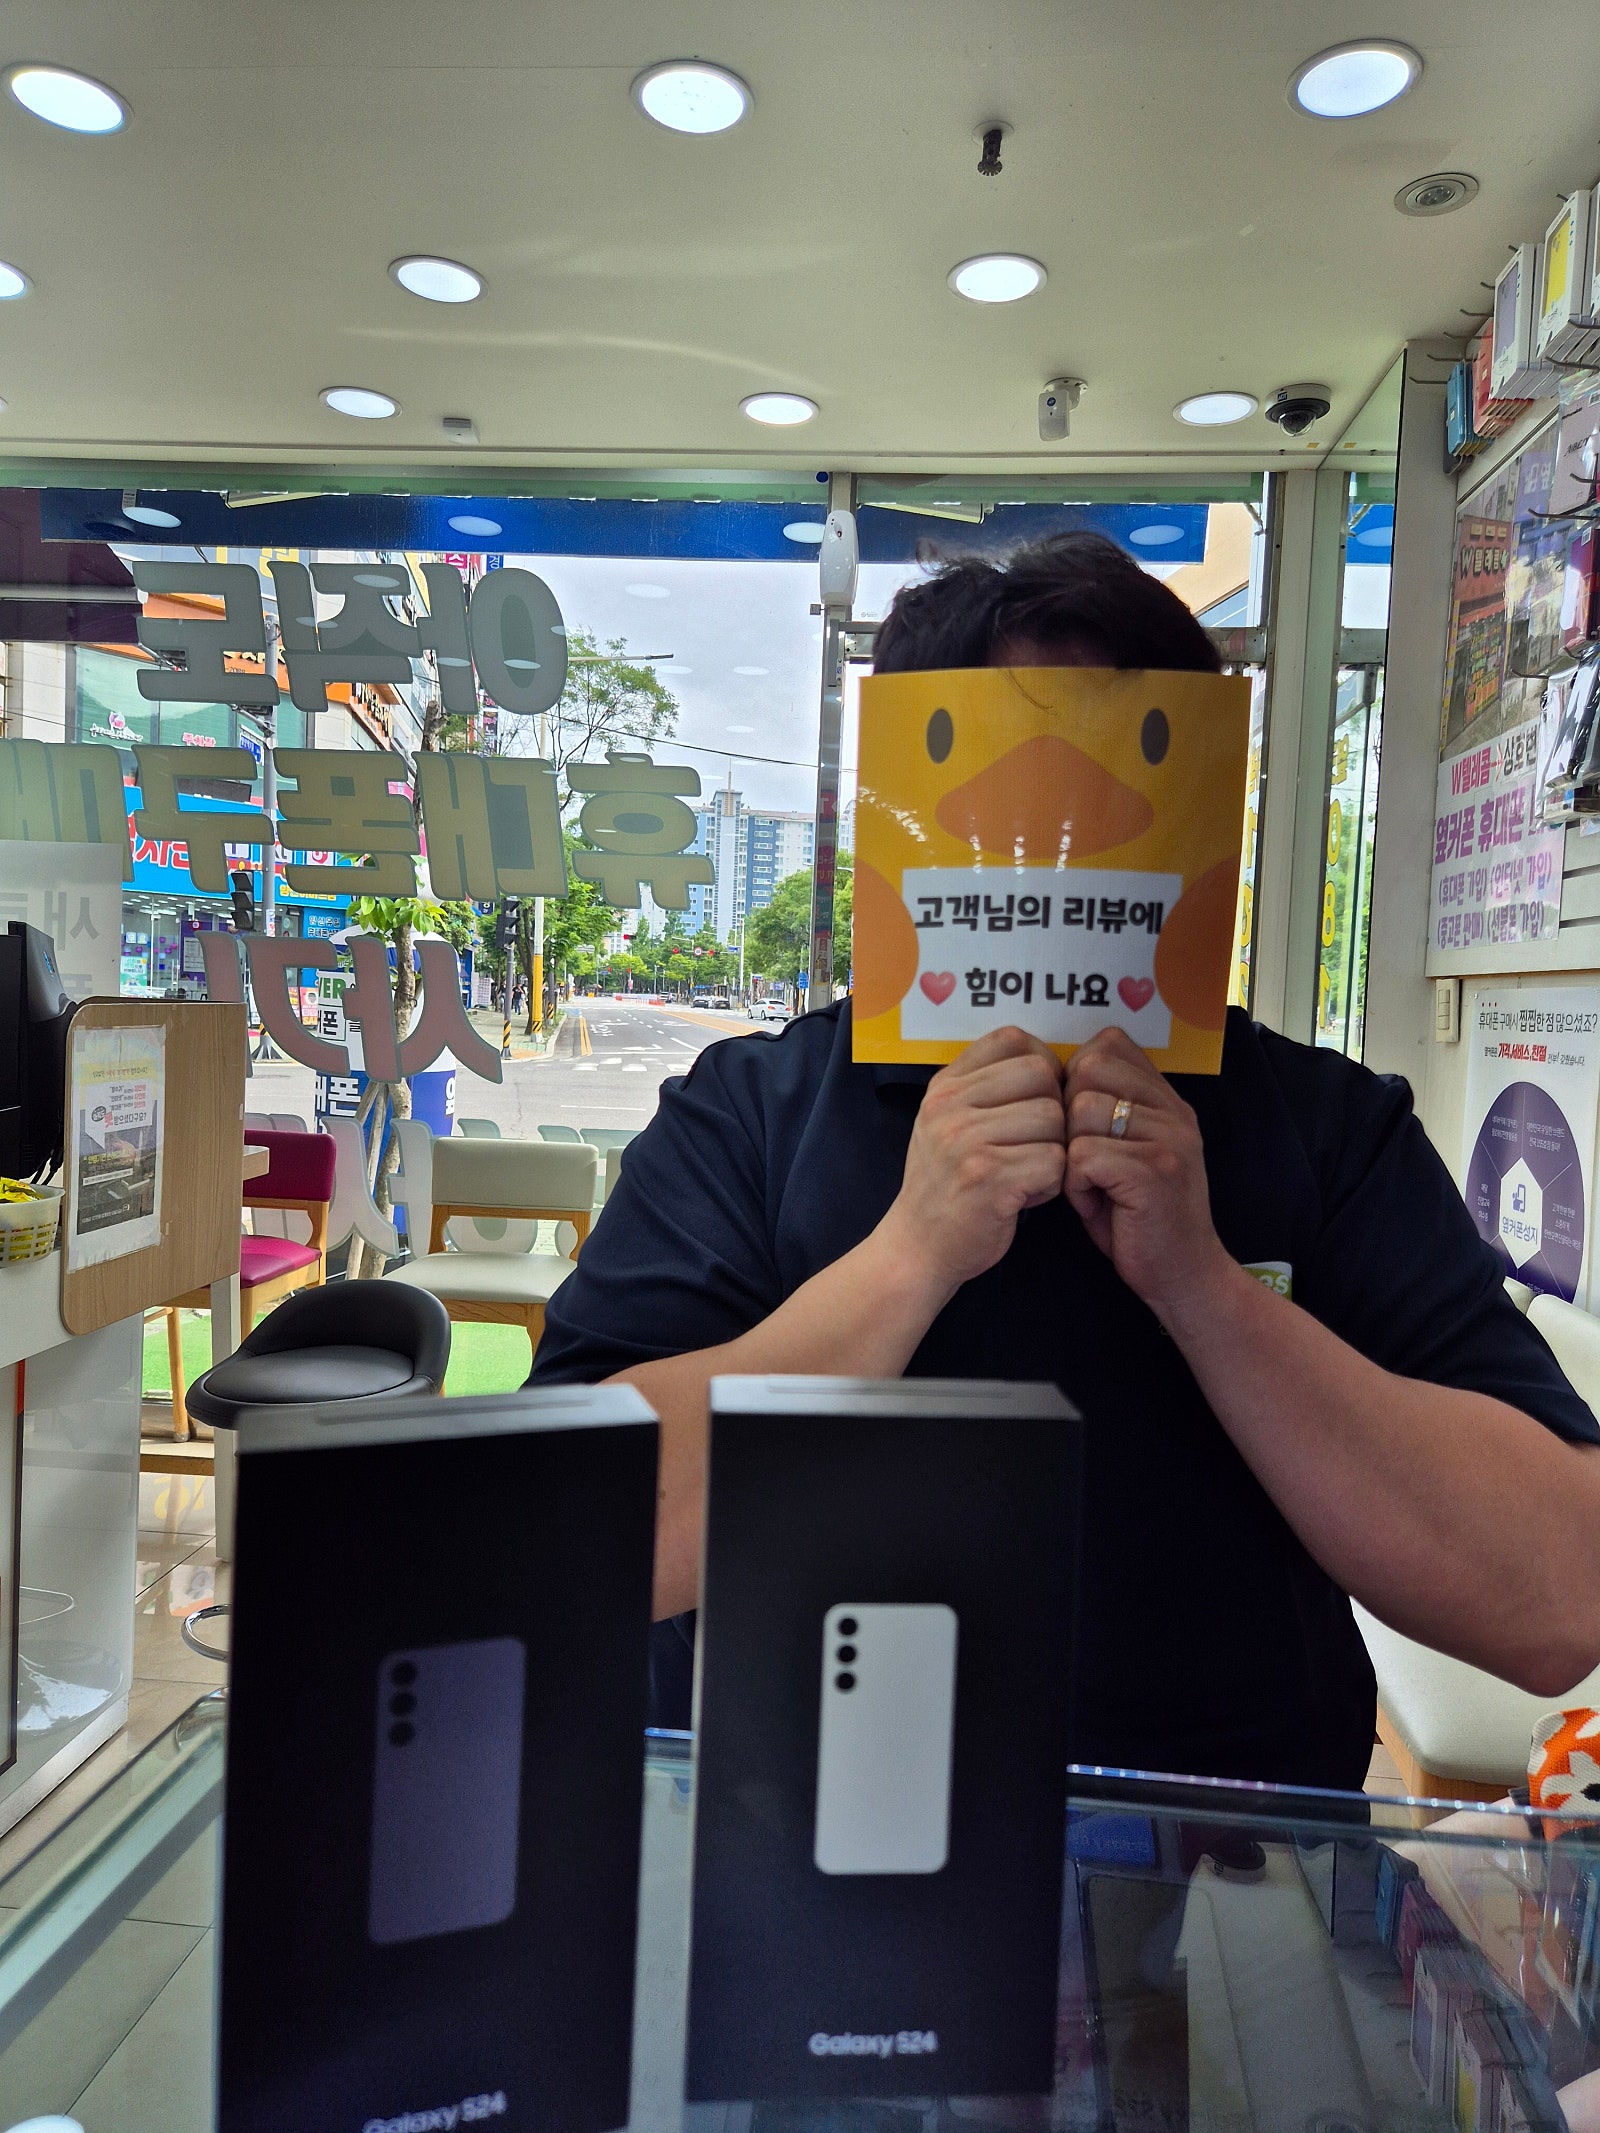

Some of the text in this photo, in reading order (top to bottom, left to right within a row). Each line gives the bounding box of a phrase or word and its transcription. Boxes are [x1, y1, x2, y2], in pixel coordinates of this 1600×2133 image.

[1452, 747, 1491, 796] W텔레콤
[1478, 786, 1526, 853] 휴대폰
[1467, 867, 1488, 903] 가입)
[1527, 851, 1553, 890] 가입)
[915, 894, 1164, 934] 고객님의 리뷰에
[1519, 900, 1545, 938] 가입)
[965, 967, 1110, 1008] 힘이 나요
[1478, 1012, 1499, 1031] 휴대폰
[1555, 1013, 1598, 1033] 많으셨죠?
[809, 2030, 939, 2058] Galaxy S24
[363, 2090, 507, 2133] Galaxy S24
